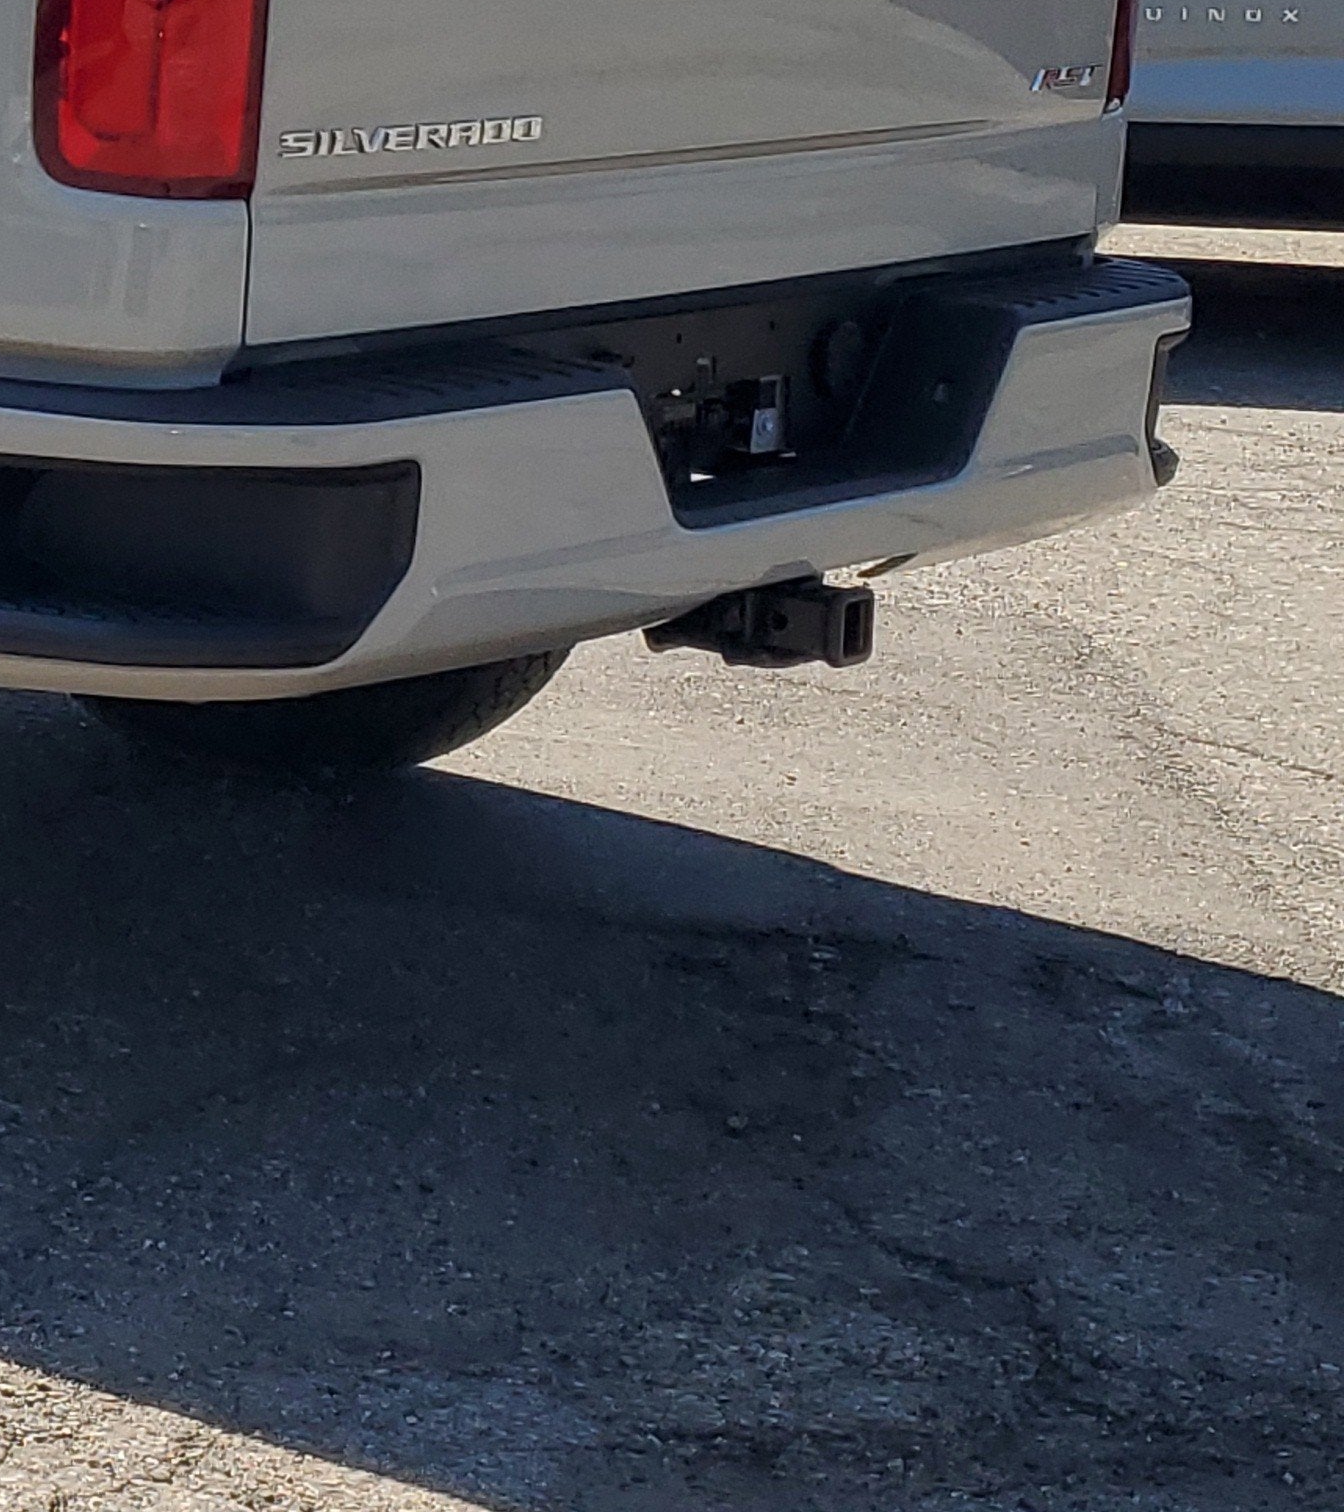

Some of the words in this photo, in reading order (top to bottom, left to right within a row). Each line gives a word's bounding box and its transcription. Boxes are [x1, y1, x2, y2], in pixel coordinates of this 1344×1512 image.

[1144, 6, 1299, 23] UINOX
[1029, 62, 1104, 92] RST
[277, 114, 544, 159] SILVERADO
